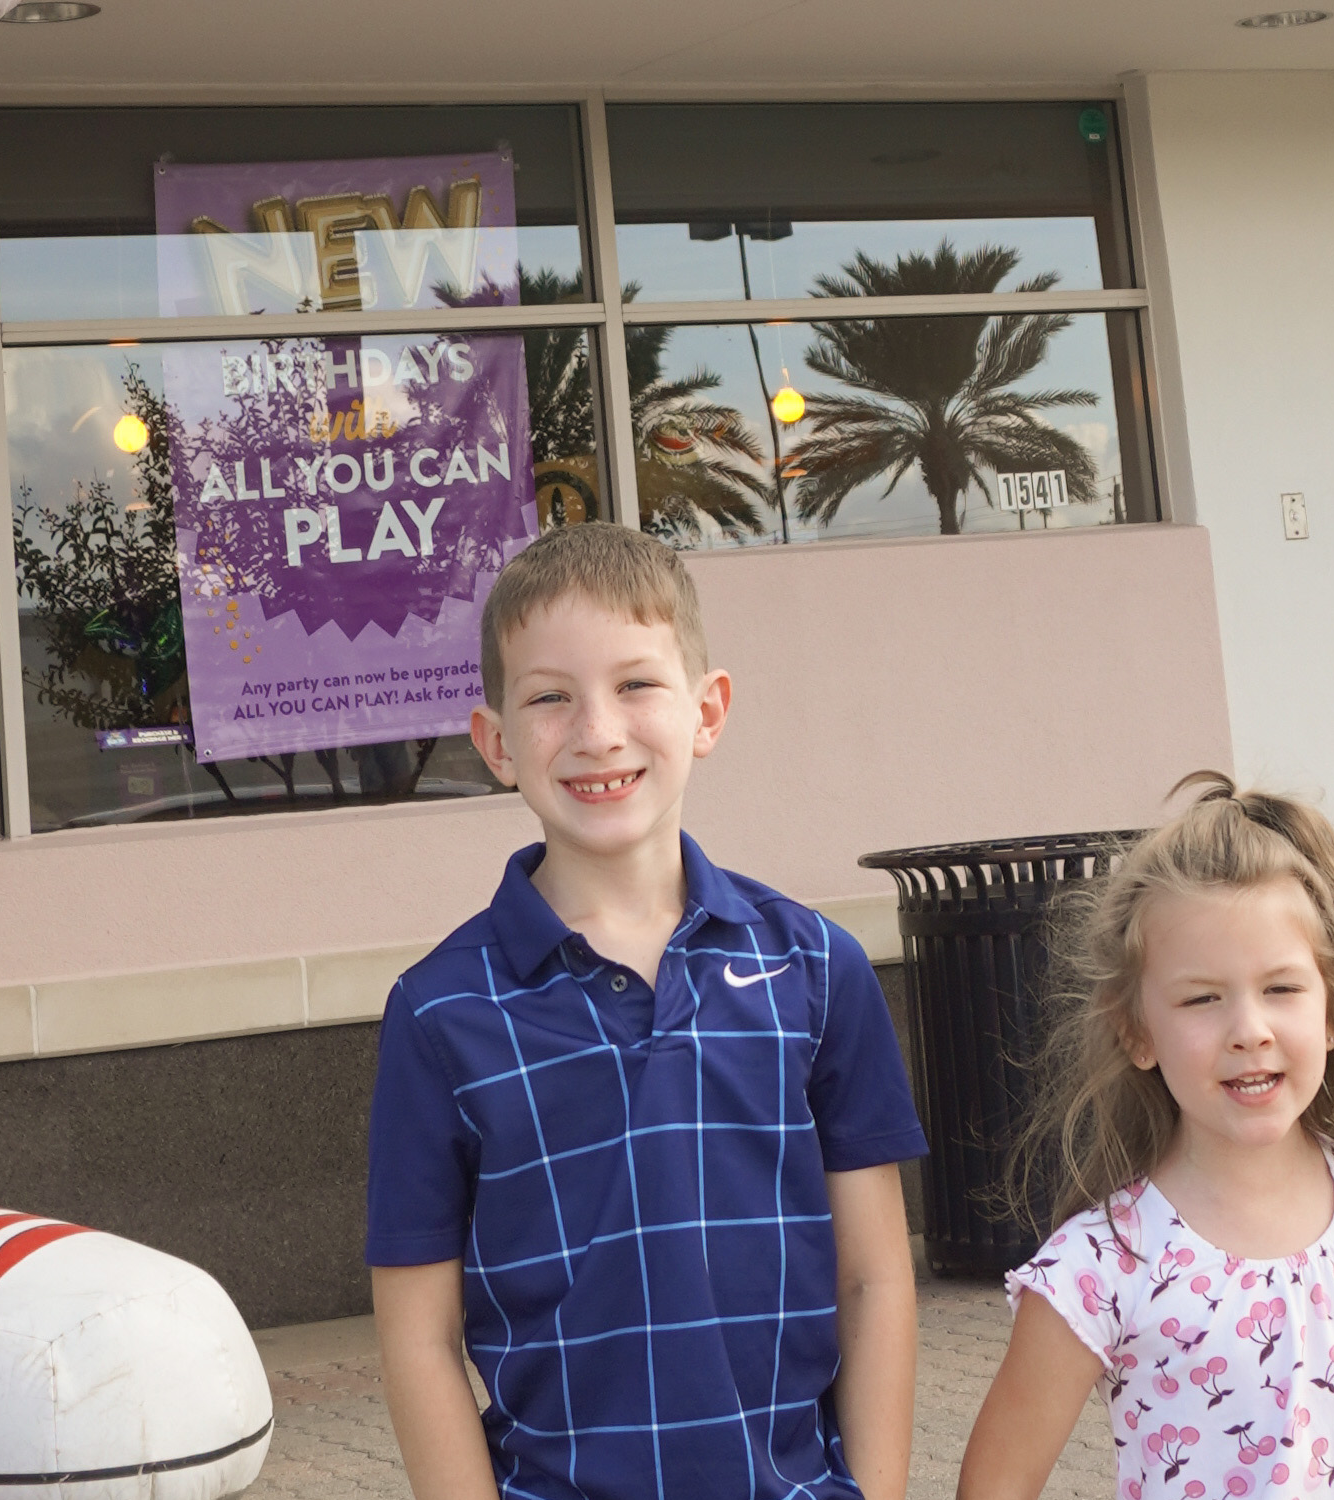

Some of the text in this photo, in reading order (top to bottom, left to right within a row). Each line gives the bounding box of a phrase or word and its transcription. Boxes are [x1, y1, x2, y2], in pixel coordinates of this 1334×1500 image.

[189, 177, 483, 315] NEW
[221, 342, 475, 397] BIRTHDAYS
[309, 398, 399, 443] with
[199, 442, 513, 502] ALL YOU CAN
[1002, 473, 1065, 507] 1541
[282, 497, 446, 567] PLAY
[234, 702, 265, 721] ALL
[269, 699, 307, 717] YOU
[311, 694, 350, 713] CAN
[354, 690, 399, 708] PLAY!
[404, 687, 432, 703] Ask
[436, 684, 460, 700] for
[241, 660, 482, 698] Any party can now be upgrade
